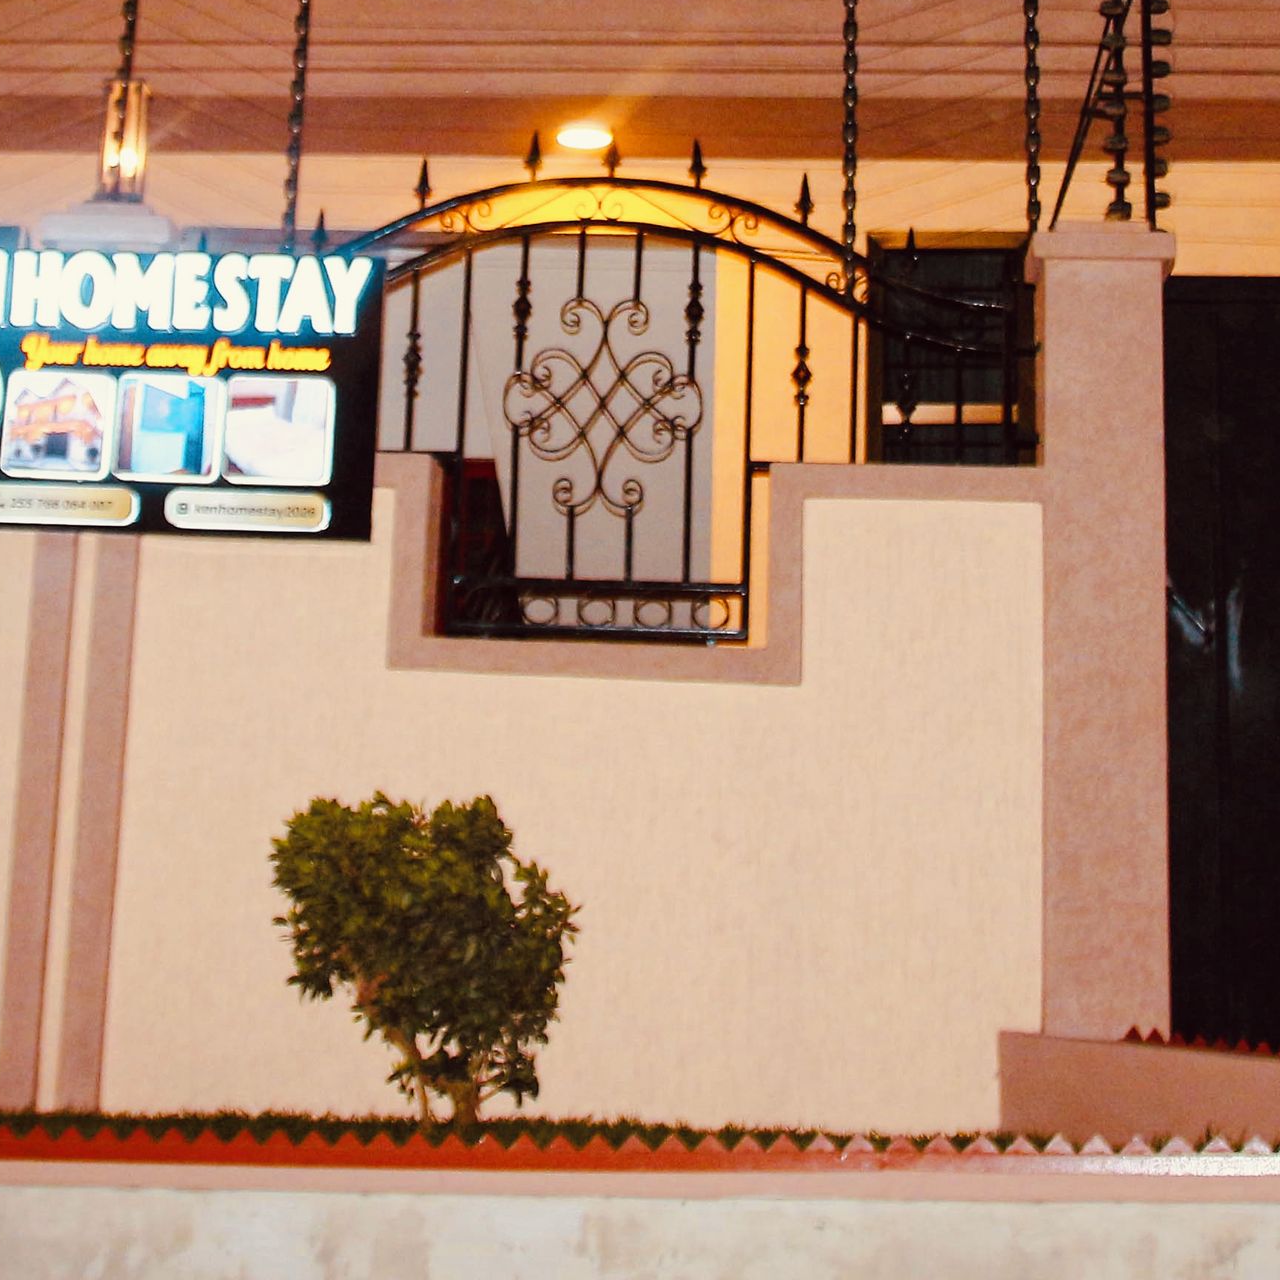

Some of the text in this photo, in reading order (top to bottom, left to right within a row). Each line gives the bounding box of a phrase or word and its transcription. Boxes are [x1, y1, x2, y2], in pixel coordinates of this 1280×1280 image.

[10, 249, 374, 336] HOMESTAY
[21, 332, 332, 376] Your home away from home
